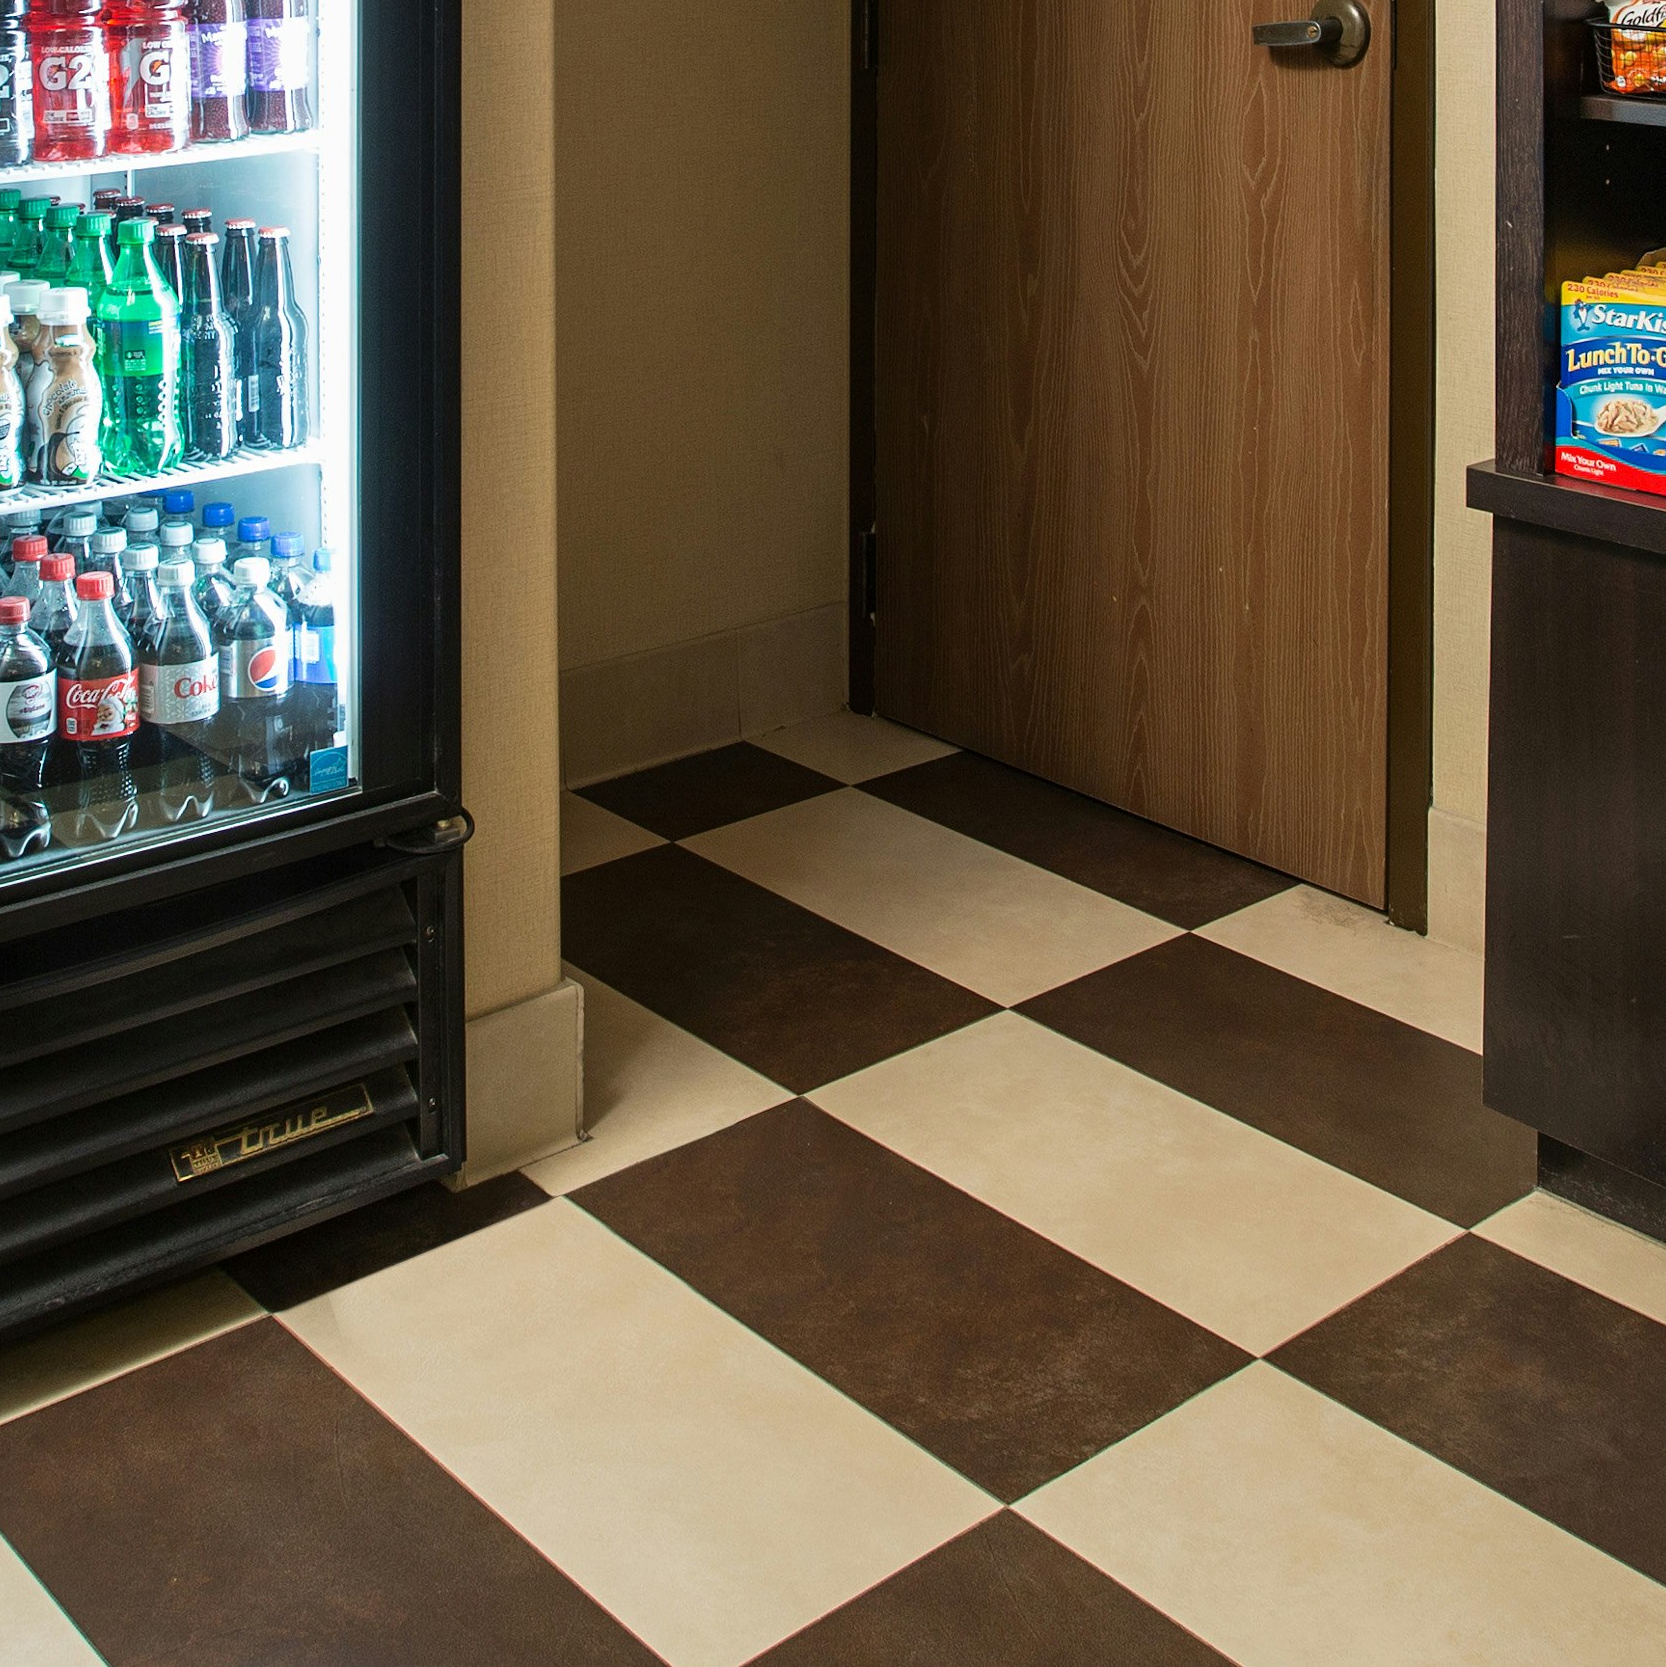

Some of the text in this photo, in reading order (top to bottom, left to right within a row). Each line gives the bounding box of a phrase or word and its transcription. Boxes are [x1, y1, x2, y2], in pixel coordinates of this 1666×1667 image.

[38, 51, 94, 91] G2
[1566, 283, 1620, 299] 230 Calories
[1597, 366, 1655, 376] MIX YOUR OWN
[42, 378, 78, 418] chocolate
[1579, 382, 1644, 396] Chunk Light Tuna
[1561, 451, 1617, 473] Mix Your Own
[174, 674, 221, 700] Coke
